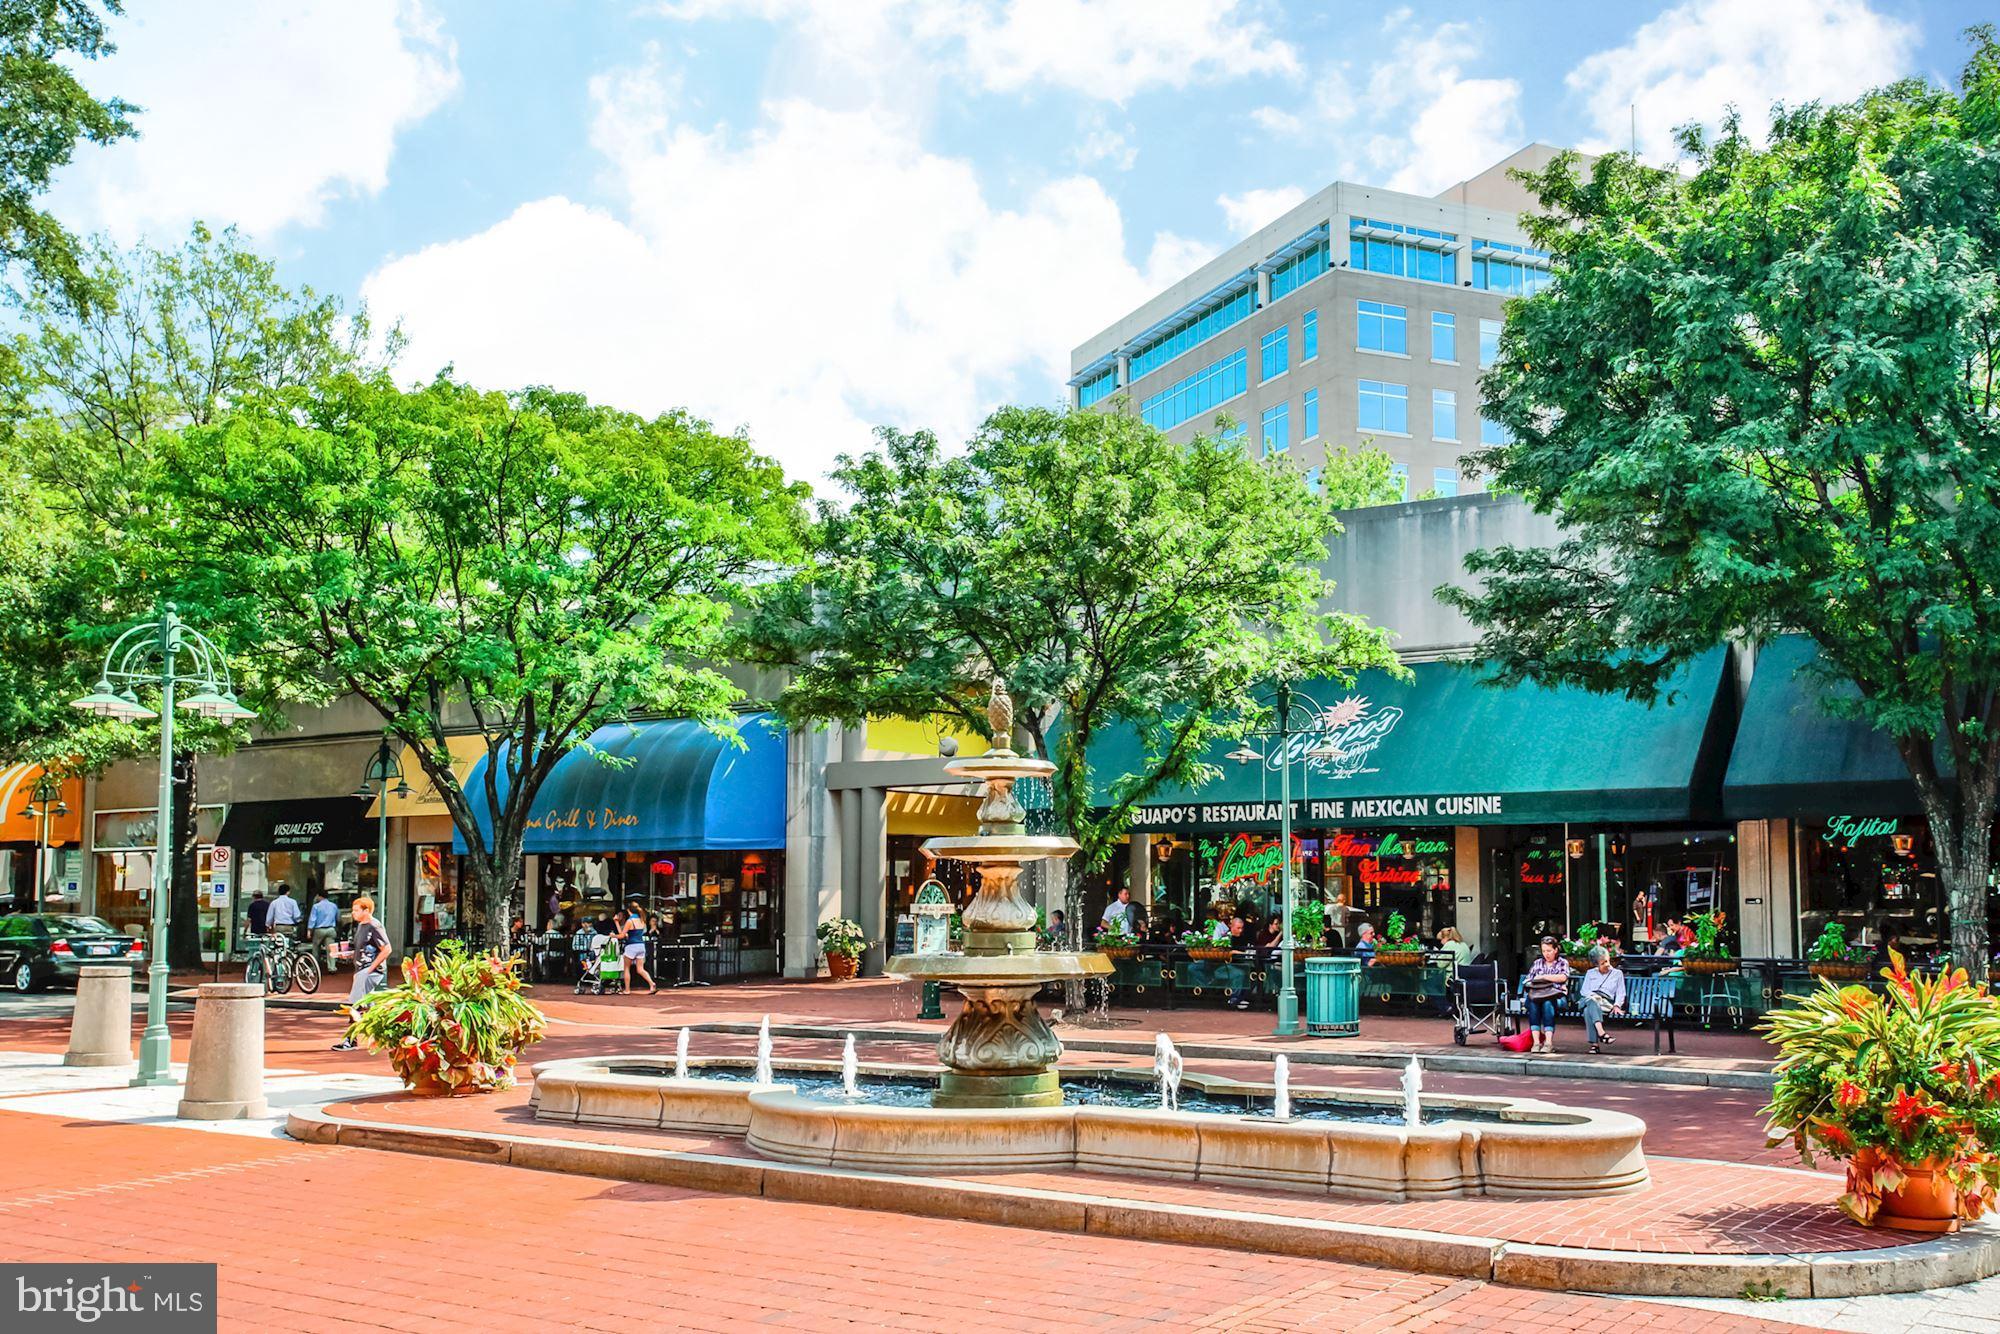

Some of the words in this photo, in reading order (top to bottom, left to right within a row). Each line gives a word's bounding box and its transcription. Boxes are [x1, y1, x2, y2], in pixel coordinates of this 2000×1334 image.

[545, 808, 580, 832] Grill
[604, 808, 640, 830] Diner
[1131, 806, 1197, 826] GUAPO'S
[1311, 801, 1345, 820] FINE
[1351, 798, 1428, 818] MEXICAN
[1435, 796, 1502, 815] CUISINE
[274, 822, 324, 835] VISUALEYES
[1822, 815, 1898, 848] Fajitas
[1373, 832, 1448, 856] Mecan
[1357, 858, 1421, 883] Cuisine
